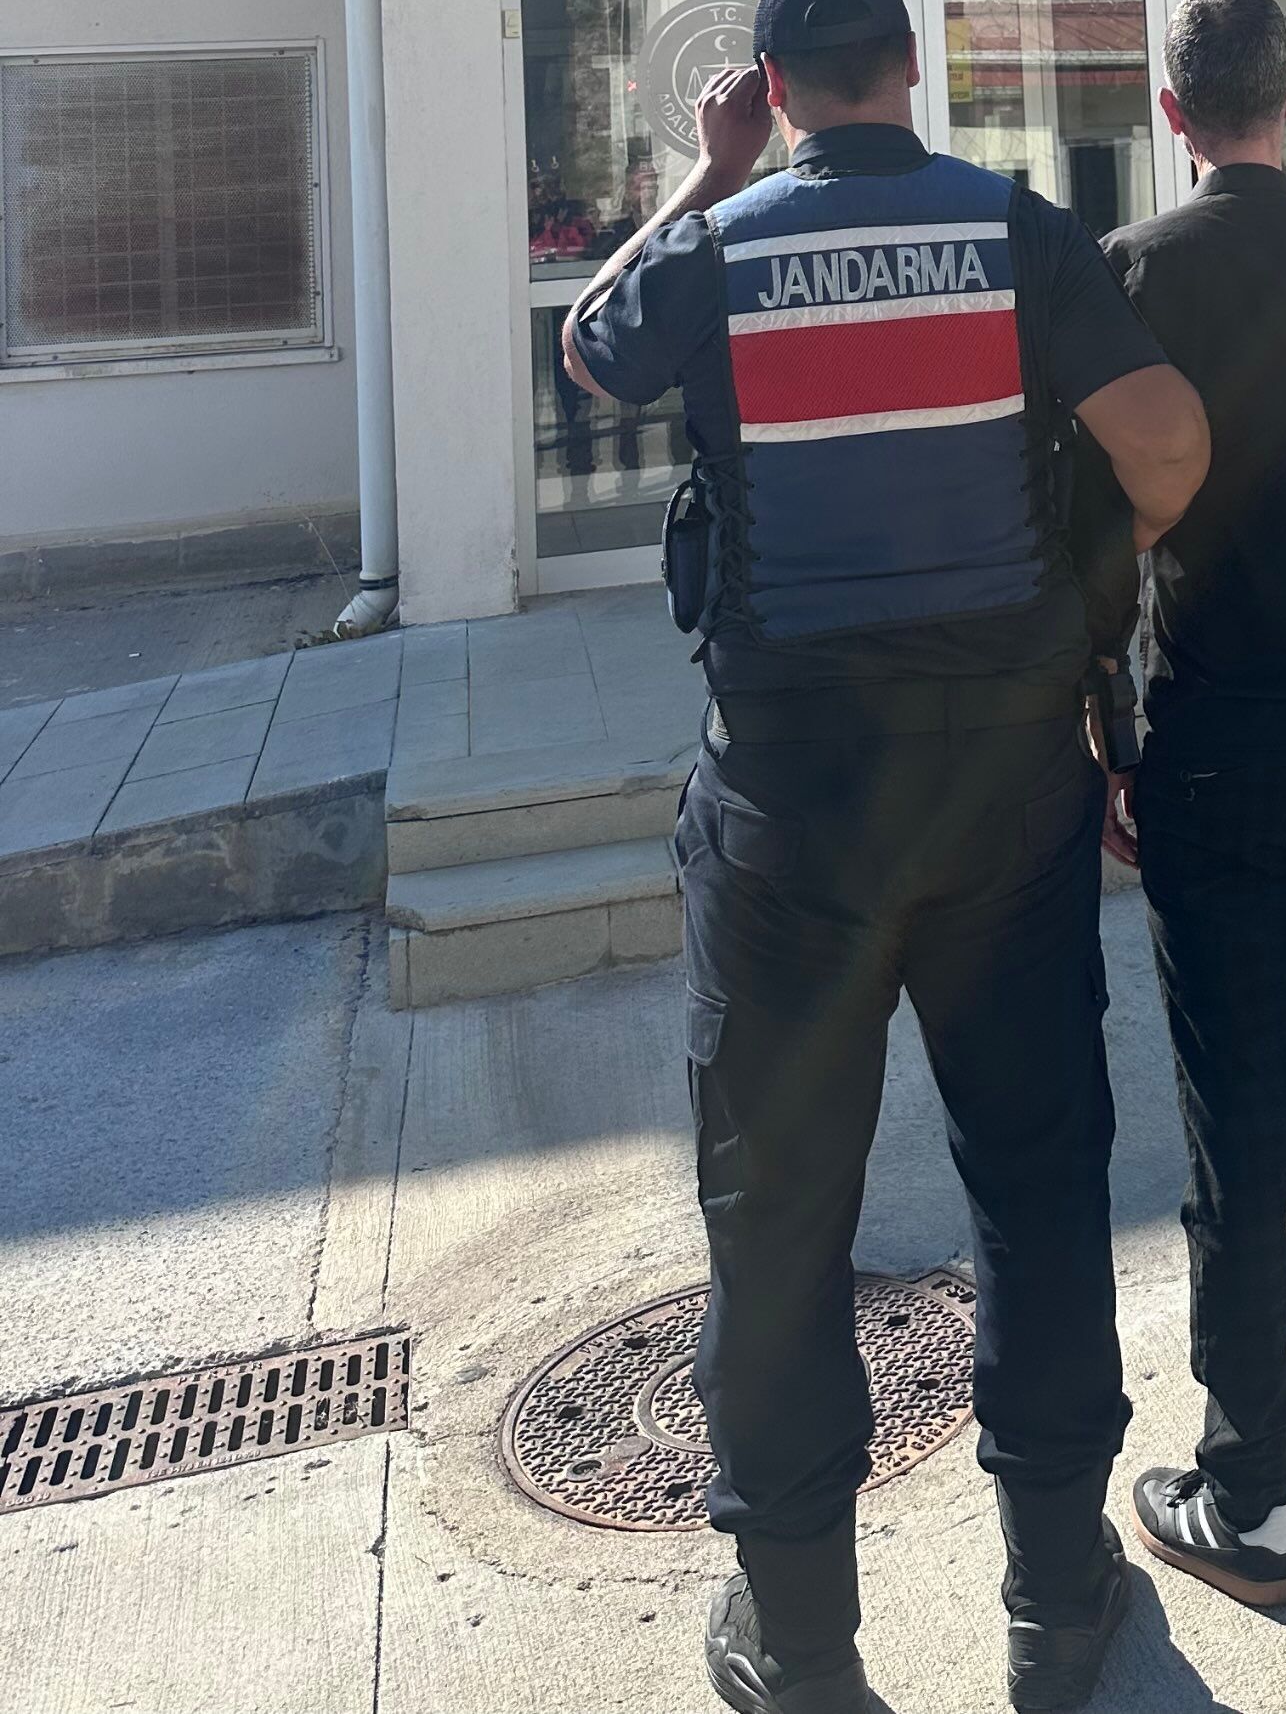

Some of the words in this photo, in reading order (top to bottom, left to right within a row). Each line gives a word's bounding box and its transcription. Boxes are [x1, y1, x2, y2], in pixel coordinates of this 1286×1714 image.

[709, 7, 742, 22] T.C.
[657, 93, 699, 142] ADALE
[758, 243, 990, 309] JANDARMA
